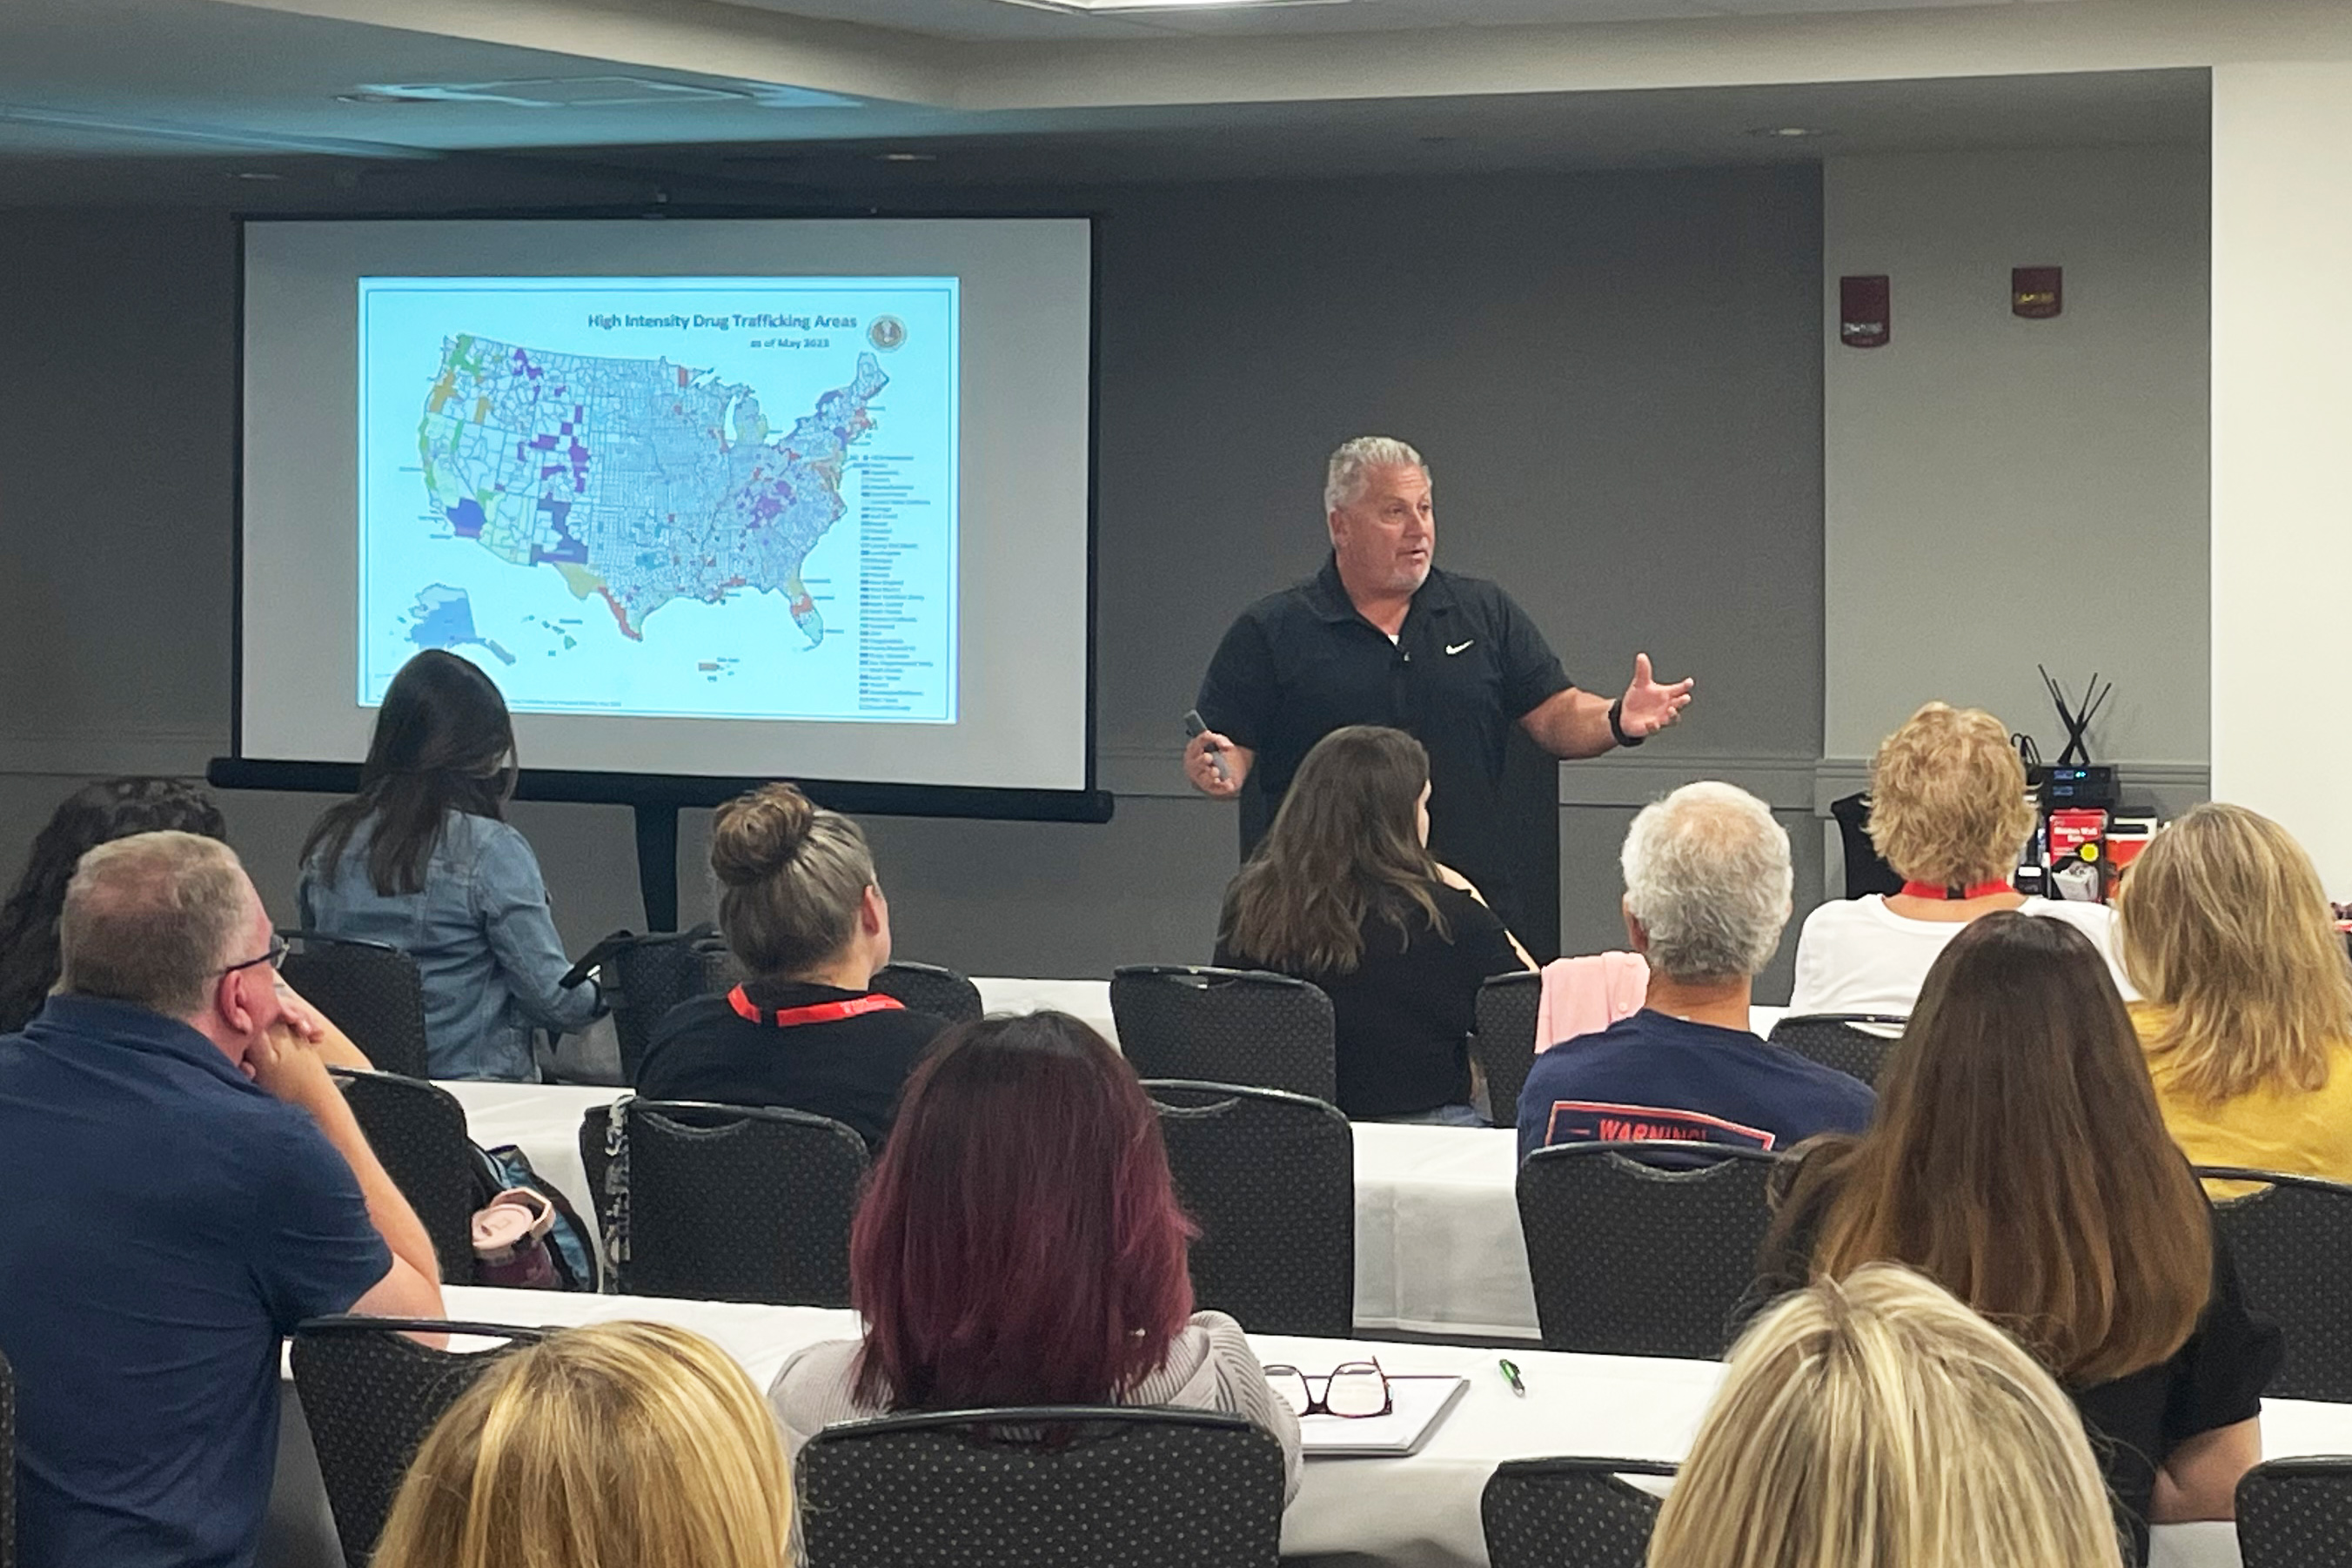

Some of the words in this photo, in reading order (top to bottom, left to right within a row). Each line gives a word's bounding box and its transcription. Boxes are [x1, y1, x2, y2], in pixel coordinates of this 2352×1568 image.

[588, 314, 621, 330] High
[625, 314, 689, 330] Intensity
[694, 314, 728, 330] Drug
[733, 314, 810, 330] Trafficking
[814, 315, 856, 329] Areas
